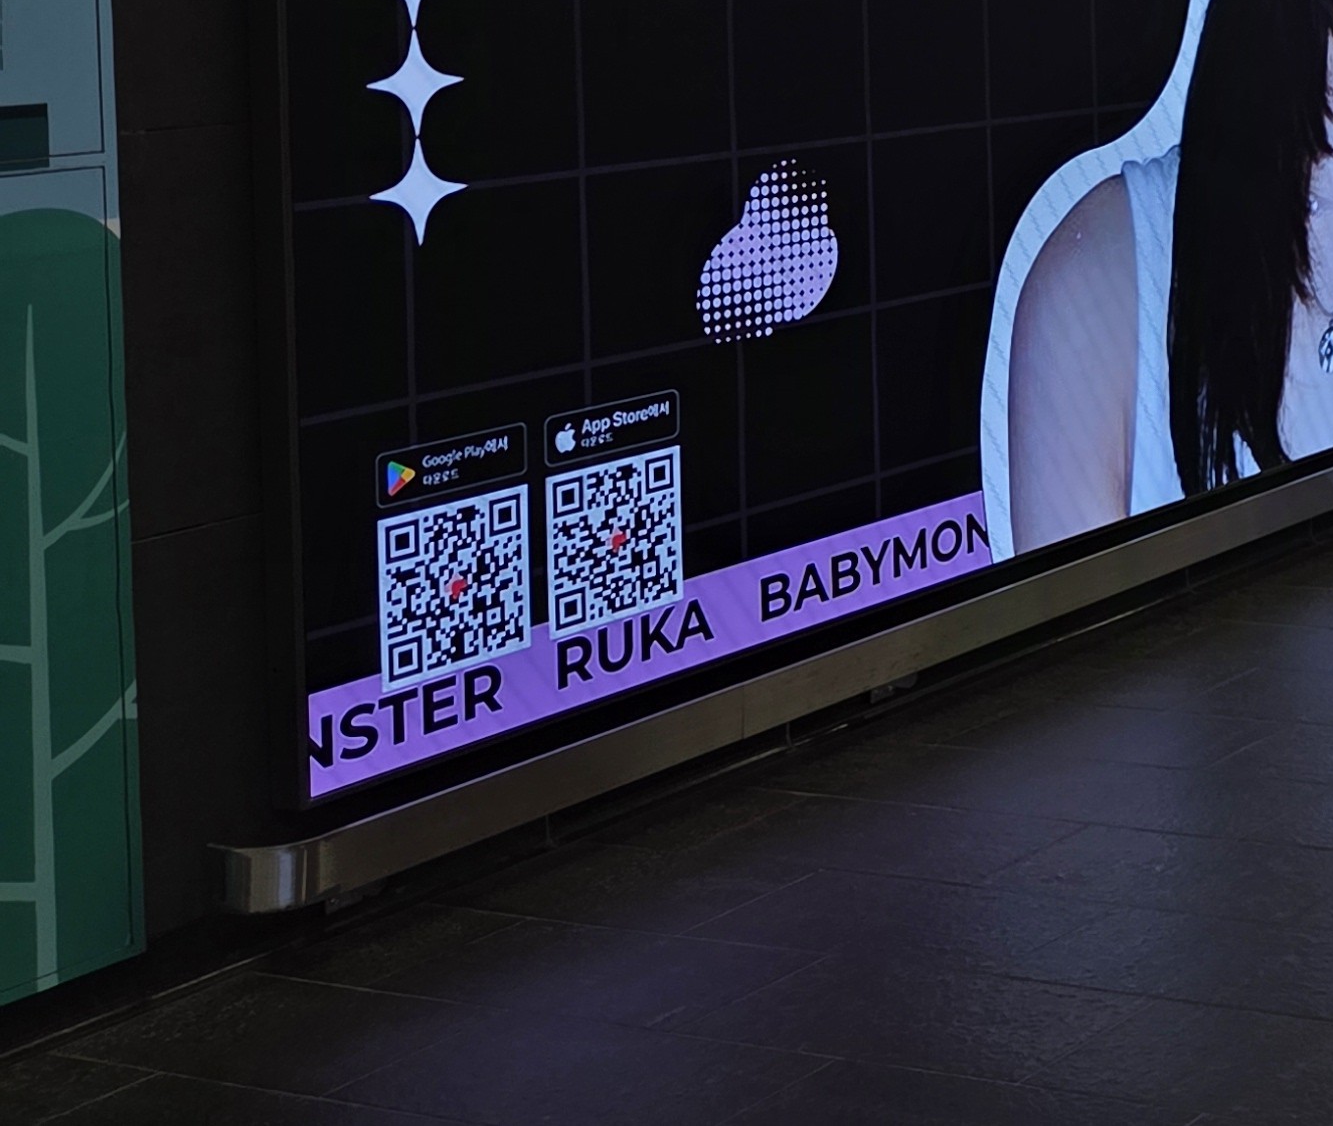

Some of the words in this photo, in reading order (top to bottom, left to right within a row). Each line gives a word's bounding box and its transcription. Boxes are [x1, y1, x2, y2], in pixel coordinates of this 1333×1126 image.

[581, 417, 611, 435] App
[612, 400, 670, 428] Store에서
[421, 448, 463, 469] Google
[556, 599, 714, 690] RUKA
[759, 513, 990, 623] BABYMON
